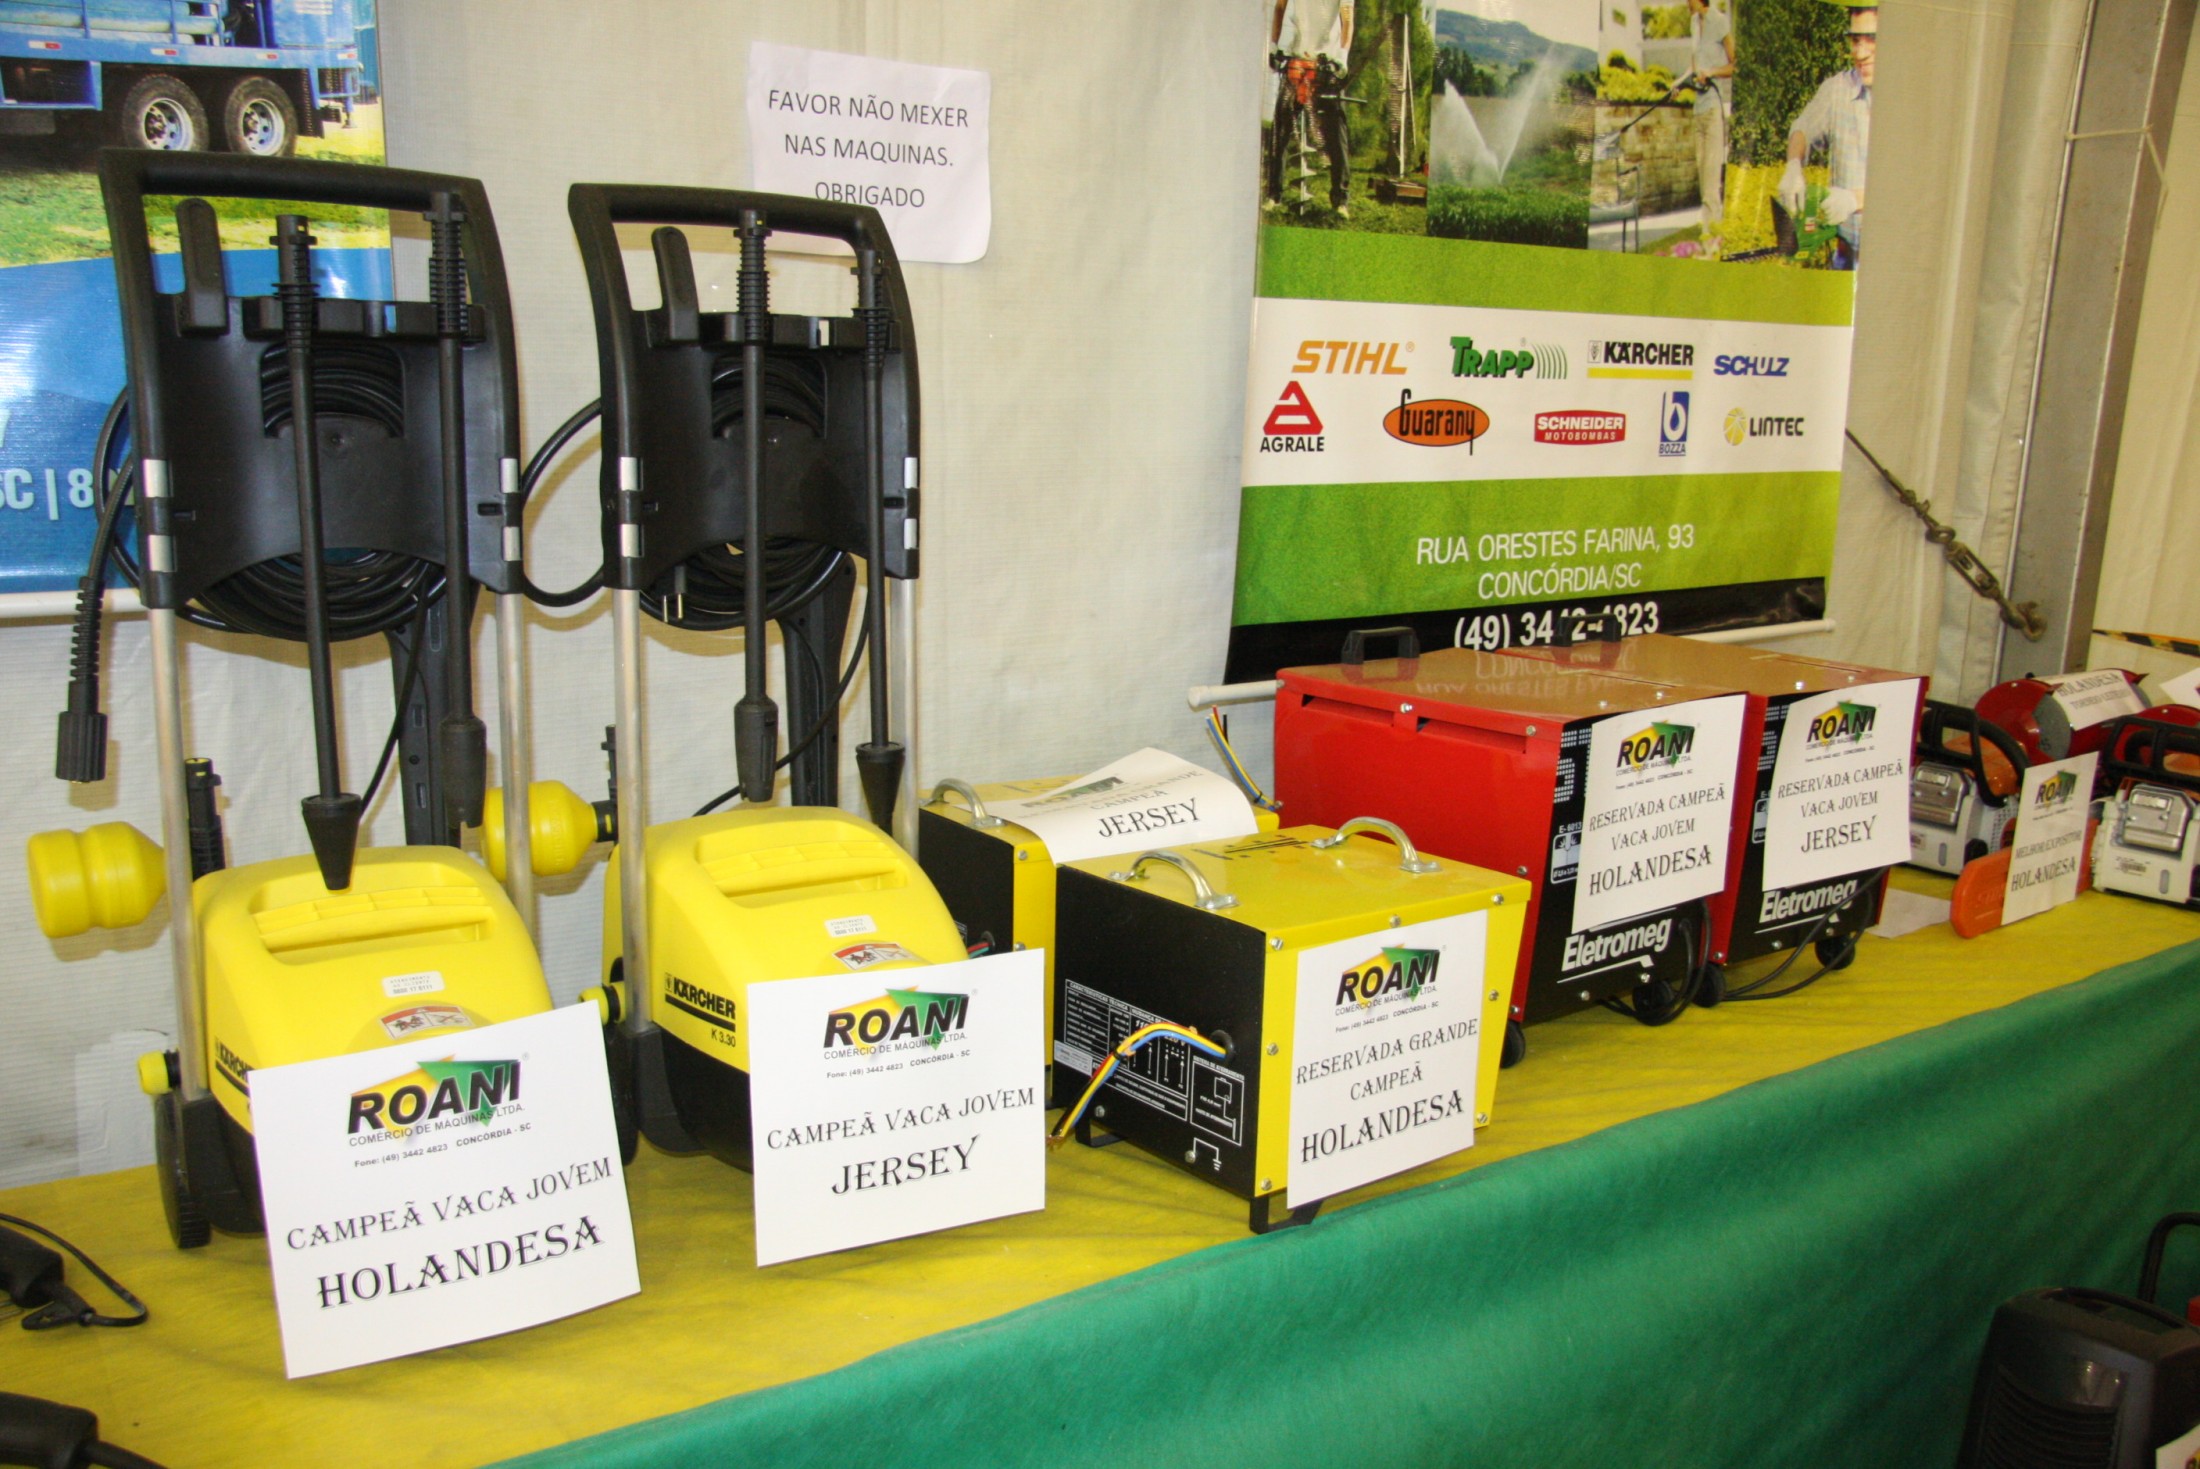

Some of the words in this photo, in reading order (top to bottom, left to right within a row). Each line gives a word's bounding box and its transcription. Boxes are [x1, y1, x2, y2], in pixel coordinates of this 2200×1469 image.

[769, 89, 842, 116] FAVOR
[849, 94, 895, 121] NÃO
[901, 103, 969, 127] MEXER
[785, 134, 826, 157] NAS
[834, 138, 954, 166] MAQUINAS.
[815, 182, 925, 208] OBRIGADO
[1291, 340, 1409, 375] STIHL
[1450, 336, 1535, 378] TRAPP
[1603, 341, 1694, 366] KÄRCHER
[1713, 354, 1790, 377] SCHULZ
[1537, 416, 1624, 430] SCHNEIDER
[1544, 431, 1616, 441] MOTOBOMBAS
[1259, 436, 1325, 453] AGRALE
[1658, 443, 1687, 455] BOZZA
[1417, 536, 1470, 565] RUA
[1478, 529, 1577, 562] ORESTES
[1584, 527, 1661, 555] FARINA,
[1668, 523, 1695, 549] 93
[1478, 562, 1642, 600] CONCÓRDIA/SC
[1454, 613, 1511, 651] (49)
[1806, 707, 1877, 743] ROANI
[1616, 728, 1695, 768] ROANI
[1777, 774, 1850, 799] RESERVADA
[1853, 759, 1904, 785] CAMPEÃ
[1098, 797, 1202, 838] JERSEY
[1589, 799, 1665, 832] RESERVADA
[1668, 782, 1726, 813] CAMPEÃ
[1800, 801, 1835, 818] VACA
[1838, 791, 1879, 811] JOVEM
[1611, 831, 1649, 852] VACA
[1652, 818, 1696, 842] JOVEM
[1801, 814, 1877, 853] JERSEY
[1589, 844, 1713, 897] HOLANDESA
[2011, 856, 2076, 892] HOLANDESA
[1758, 880, 1858, 924] Eletromeg
[1561, 918, 1673, 972] Eletromeg
[1335, 950, 1441, 1006] ROANI
[823, 995, 970, 1049] ROANI
[824, 1046, 877, 1060] COMÉRCIO
[879, 1045, 892, 1054] DE
[894, 1037, 943, 1052] MÁQUINAS
[961, 1049, 971, 1058] SC
[1296, 1036, 1403, 1085] RESERVADA
[1409, 1018, 1478, 1052] GRANDE
[347, 1061, 521, 1135] ROANI
[1350, 1060, 1423, 1101] CAMPEÃ
[349, 1127, 413, 1148] COMÉRCIO
[416, 1124, 432, 1136] DE
[434, 1110, 494, 1131] MÁQUINAS
[496, 1103, 526, 1118] LTDA.
[767, 1112, 878, 1150] CAMPEÃ
[885, 1103, 953, 1132] VACA
[959, 1087, 1036, 1118] JOVEM
[1302, 1089, 1465, 1164] HOLANDESA
[354, 1156, 380, 1168] Fone:
[382, 1153, 400, 1165] (49)
[403, 1148, 425, 1159] 3442
[427, 1143, 448, 1155] 4823
[456, 1128, 513, 1148] CONCÓRDIA
[520, 1122, 532, 1132] SC
[831, 1134, 981, 1195] JERSEY
[288, 1201, 425, 1251] CAMPEÃ
[432, 1185, 519, 1223] VACA
[526, 1157, 614, 1202] JOVEM
[317, 1215, 604, 1310] HOLANDESA
